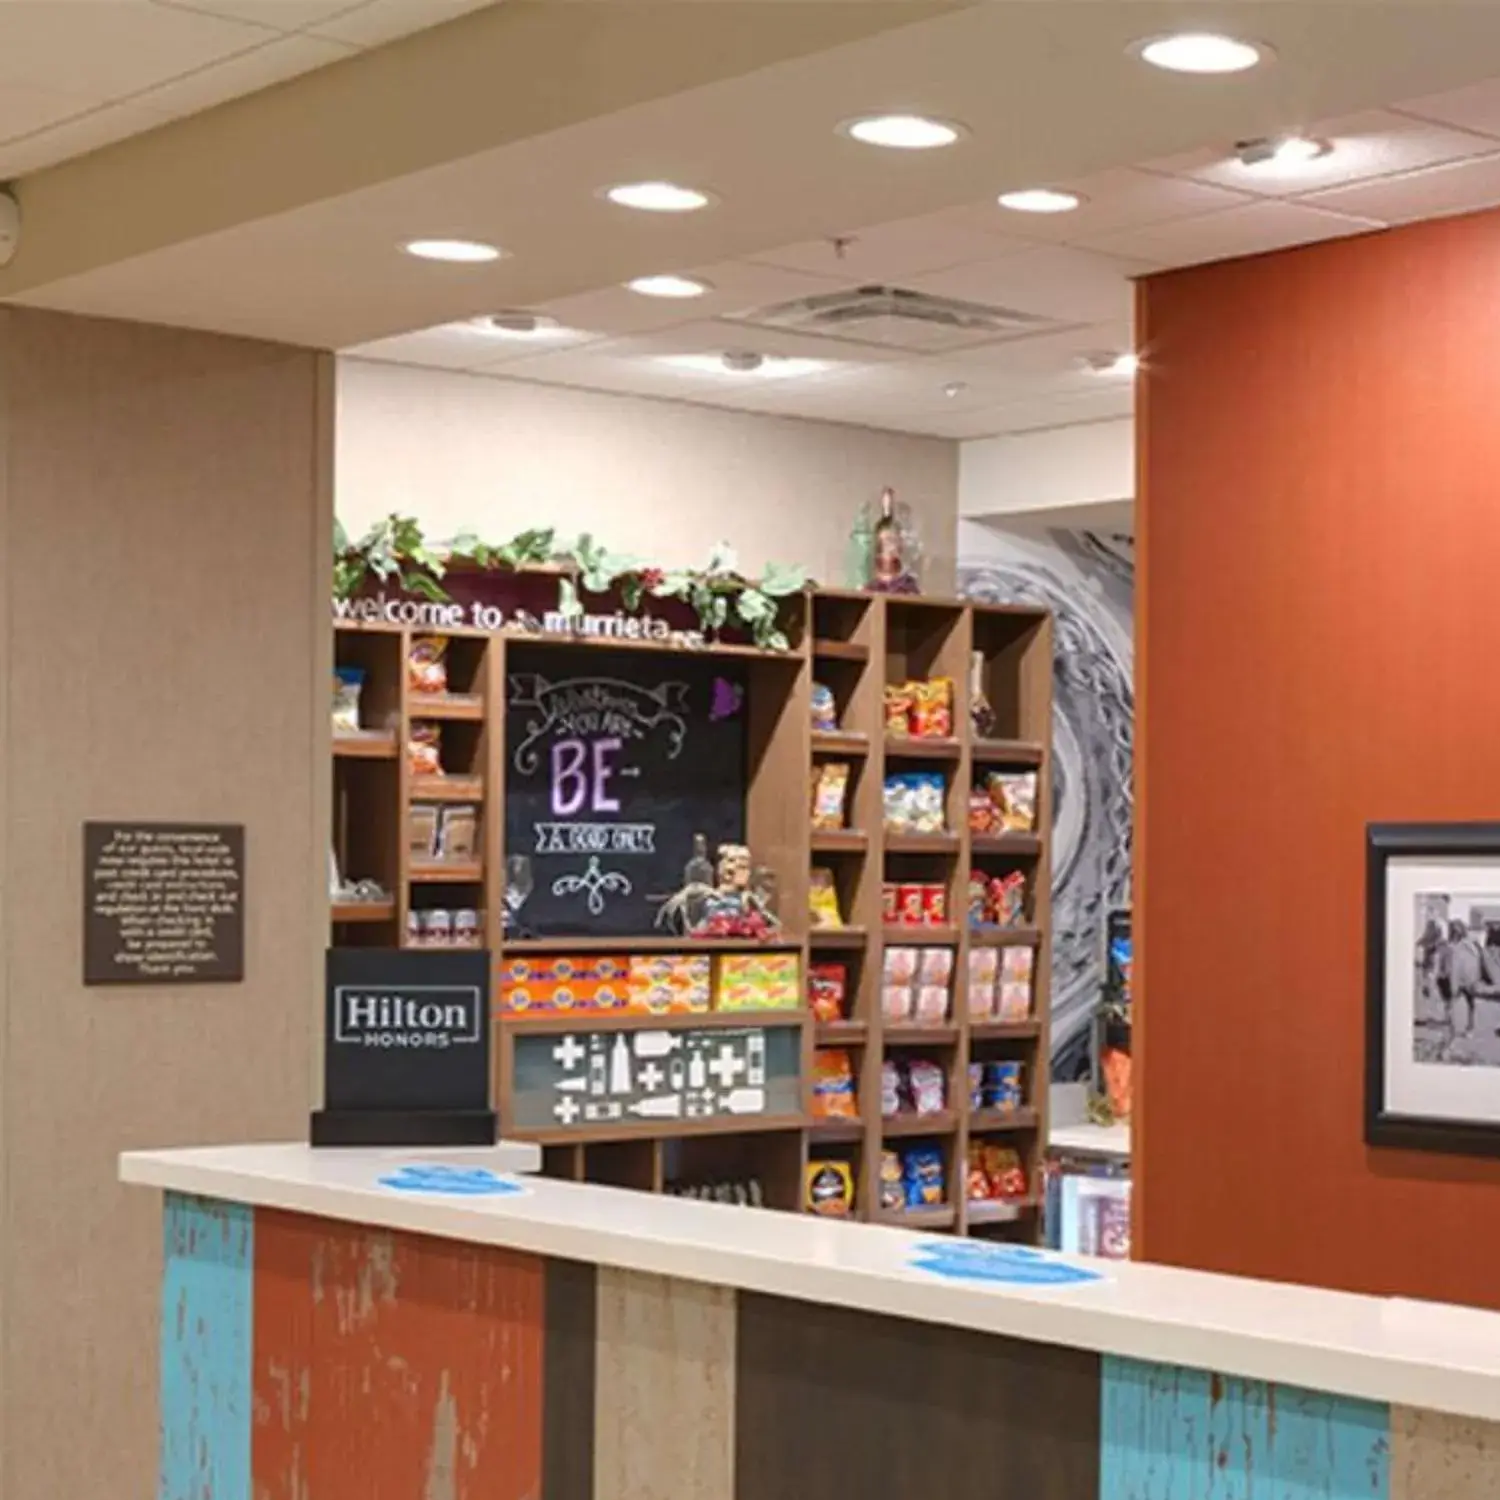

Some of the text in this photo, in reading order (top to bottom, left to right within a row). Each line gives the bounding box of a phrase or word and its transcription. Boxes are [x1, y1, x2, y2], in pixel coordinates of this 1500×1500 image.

[332, 591, 464, 626] welcome
[470, 601, 503, 629] to
[347, 995, 466, 1029] Hilton
[364, 1032, 450, 1048] HONORS
